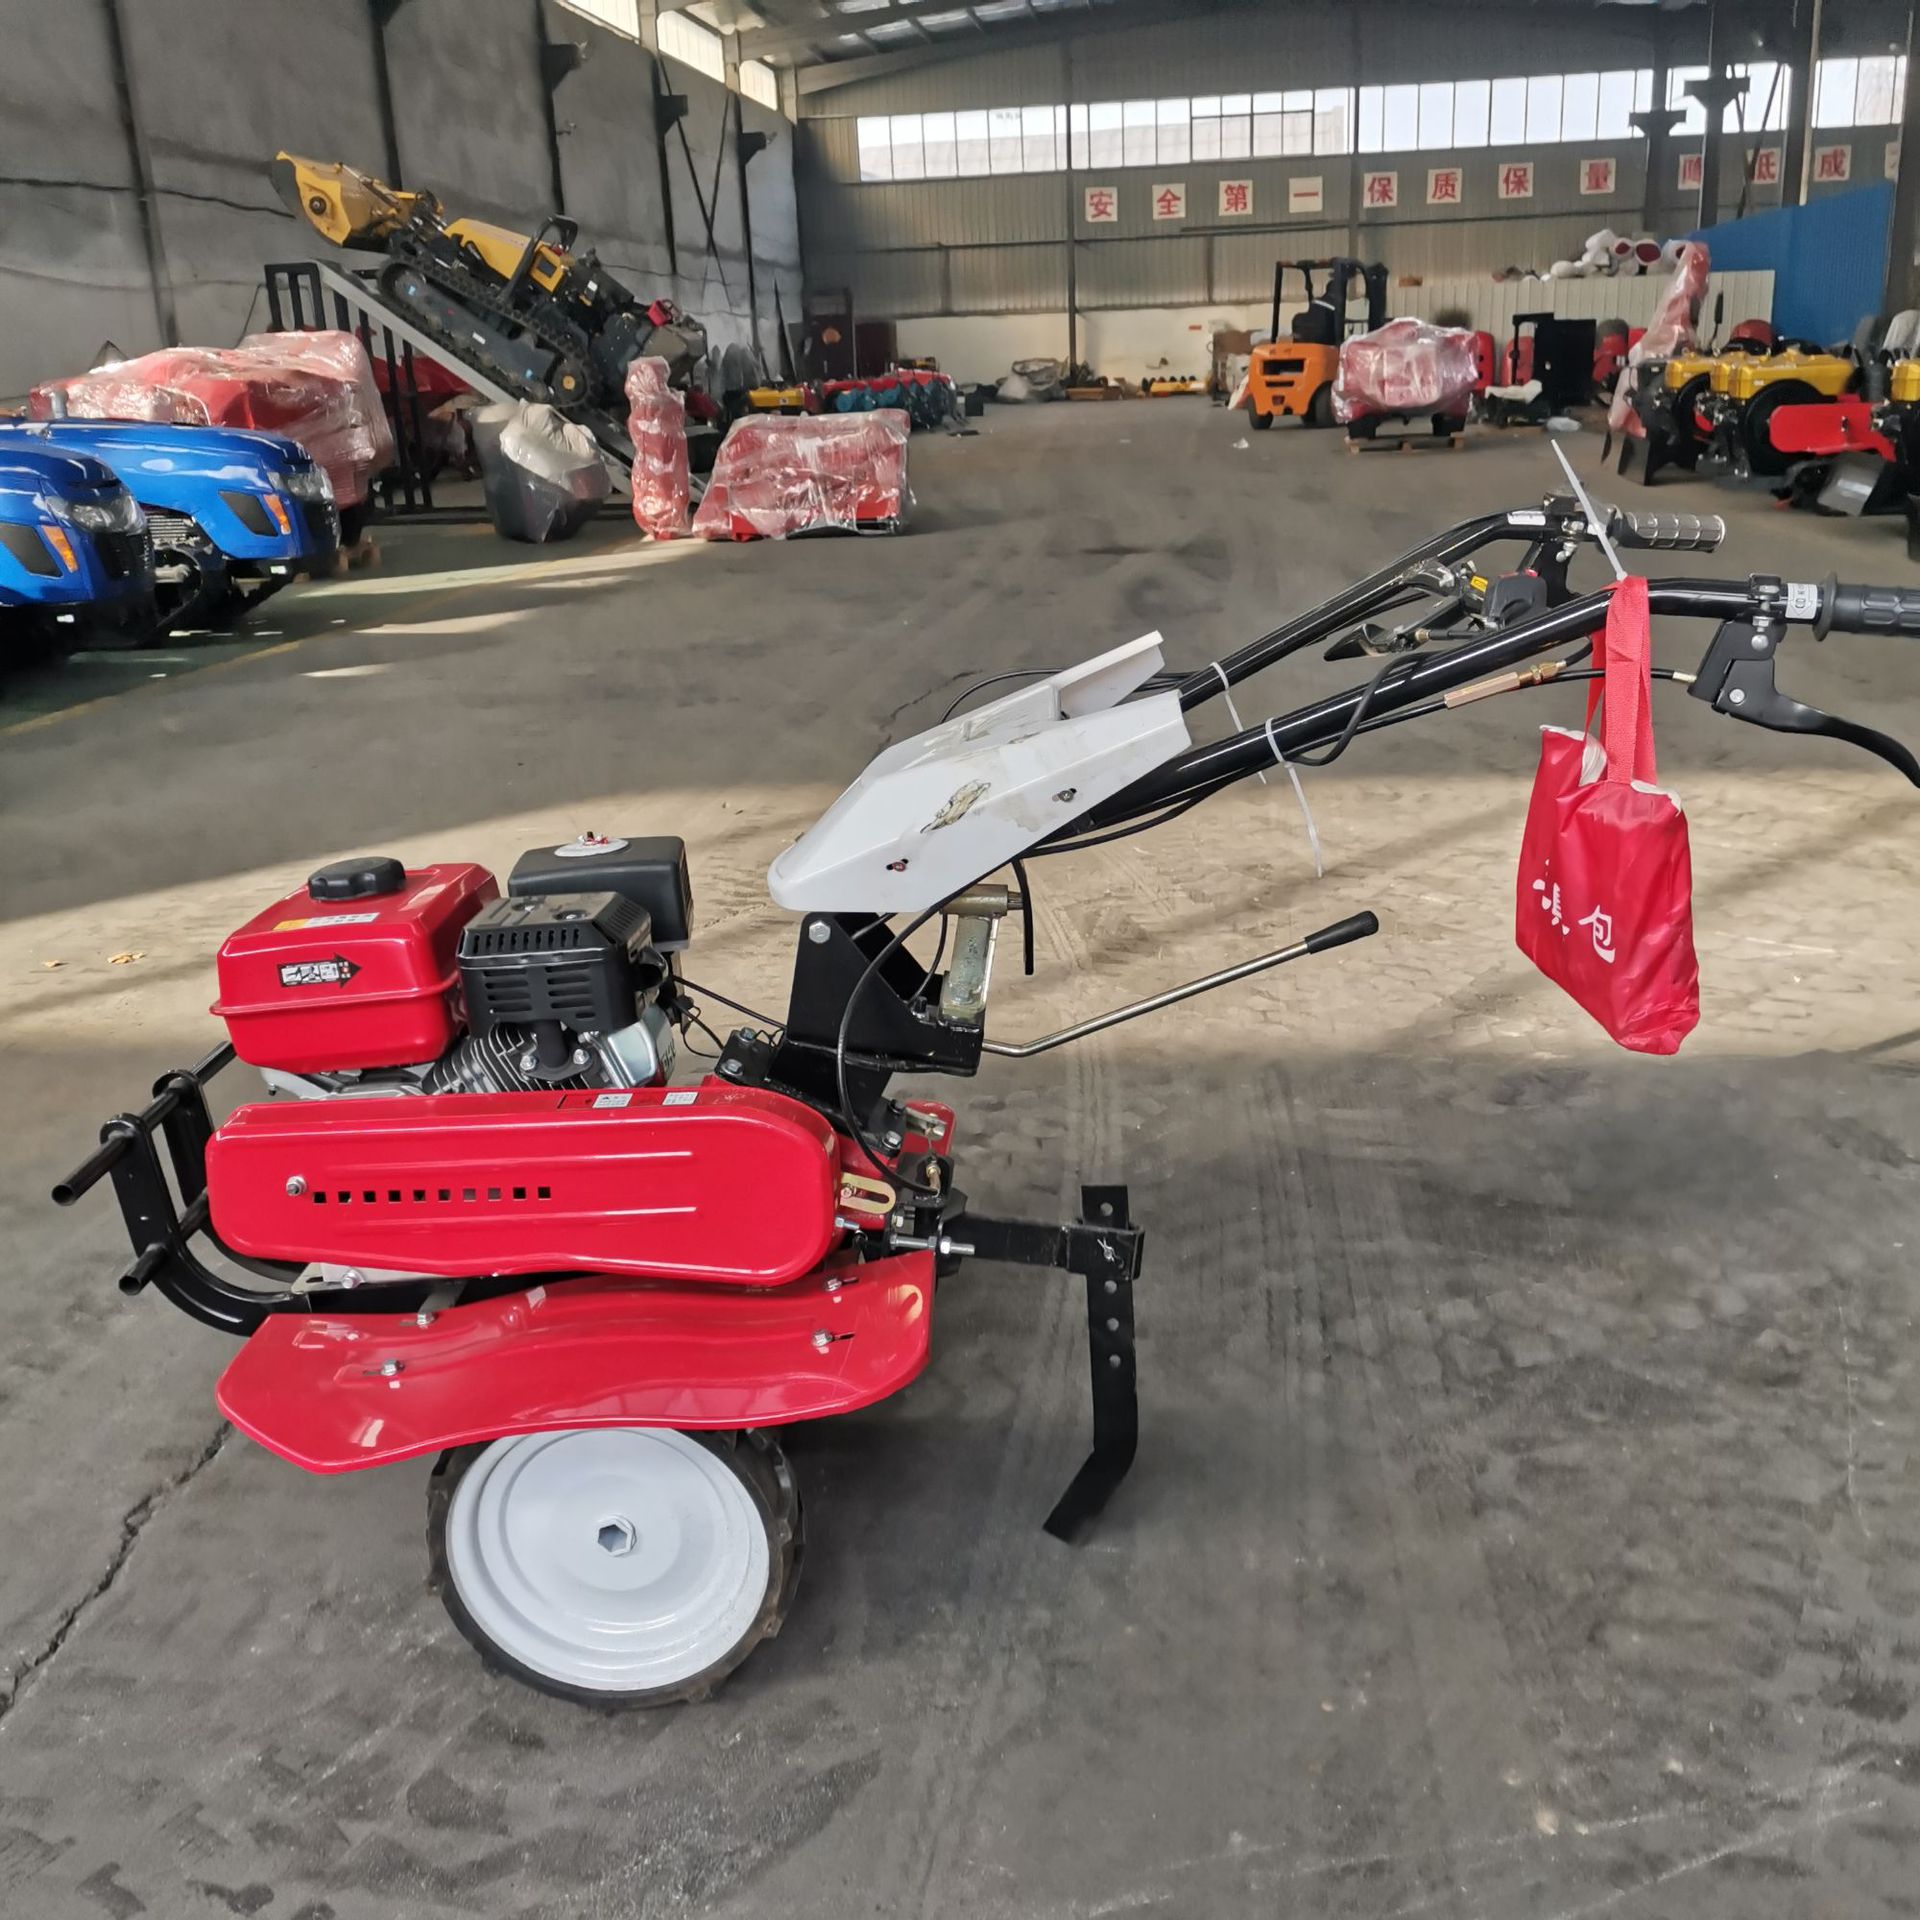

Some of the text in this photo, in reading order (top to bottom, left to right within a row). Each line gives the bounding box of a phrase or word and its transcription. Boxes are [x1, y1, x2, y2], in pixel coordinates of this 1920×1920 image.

[1088, 183, 1319, 219] 安全第一
[1367, 161, 1611, 206] 保质保量
[1577, 905, 1616, 964] 包
